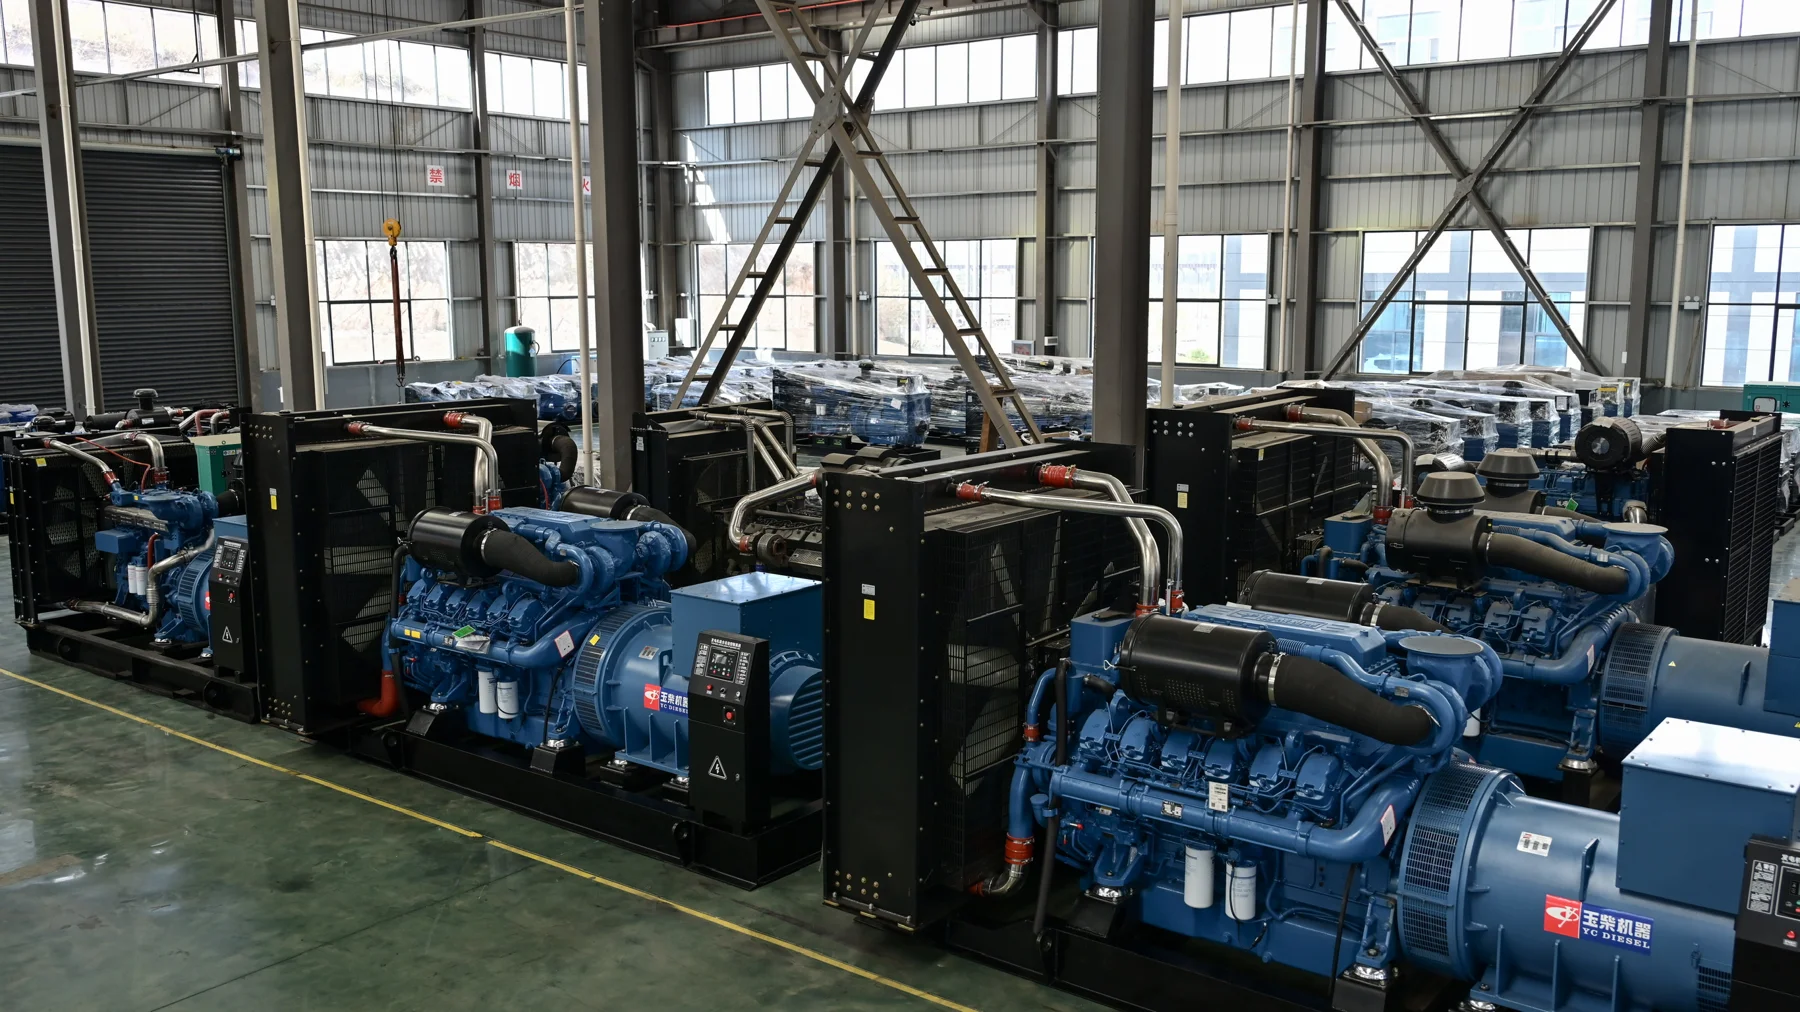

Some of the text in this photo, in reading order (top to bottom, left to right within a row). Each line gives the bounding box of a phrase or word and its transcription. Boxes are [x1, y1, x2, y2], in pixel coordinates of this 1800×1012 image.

[429, 168, 443, 183] 禁
[509, 172, 521, 187] 烟
[660, 691, 689, 708] 玉柴机器
[1582, 910, 1652, 940] 玉柴机器
[1582, 927, 1650, 949] YC DIESEL
